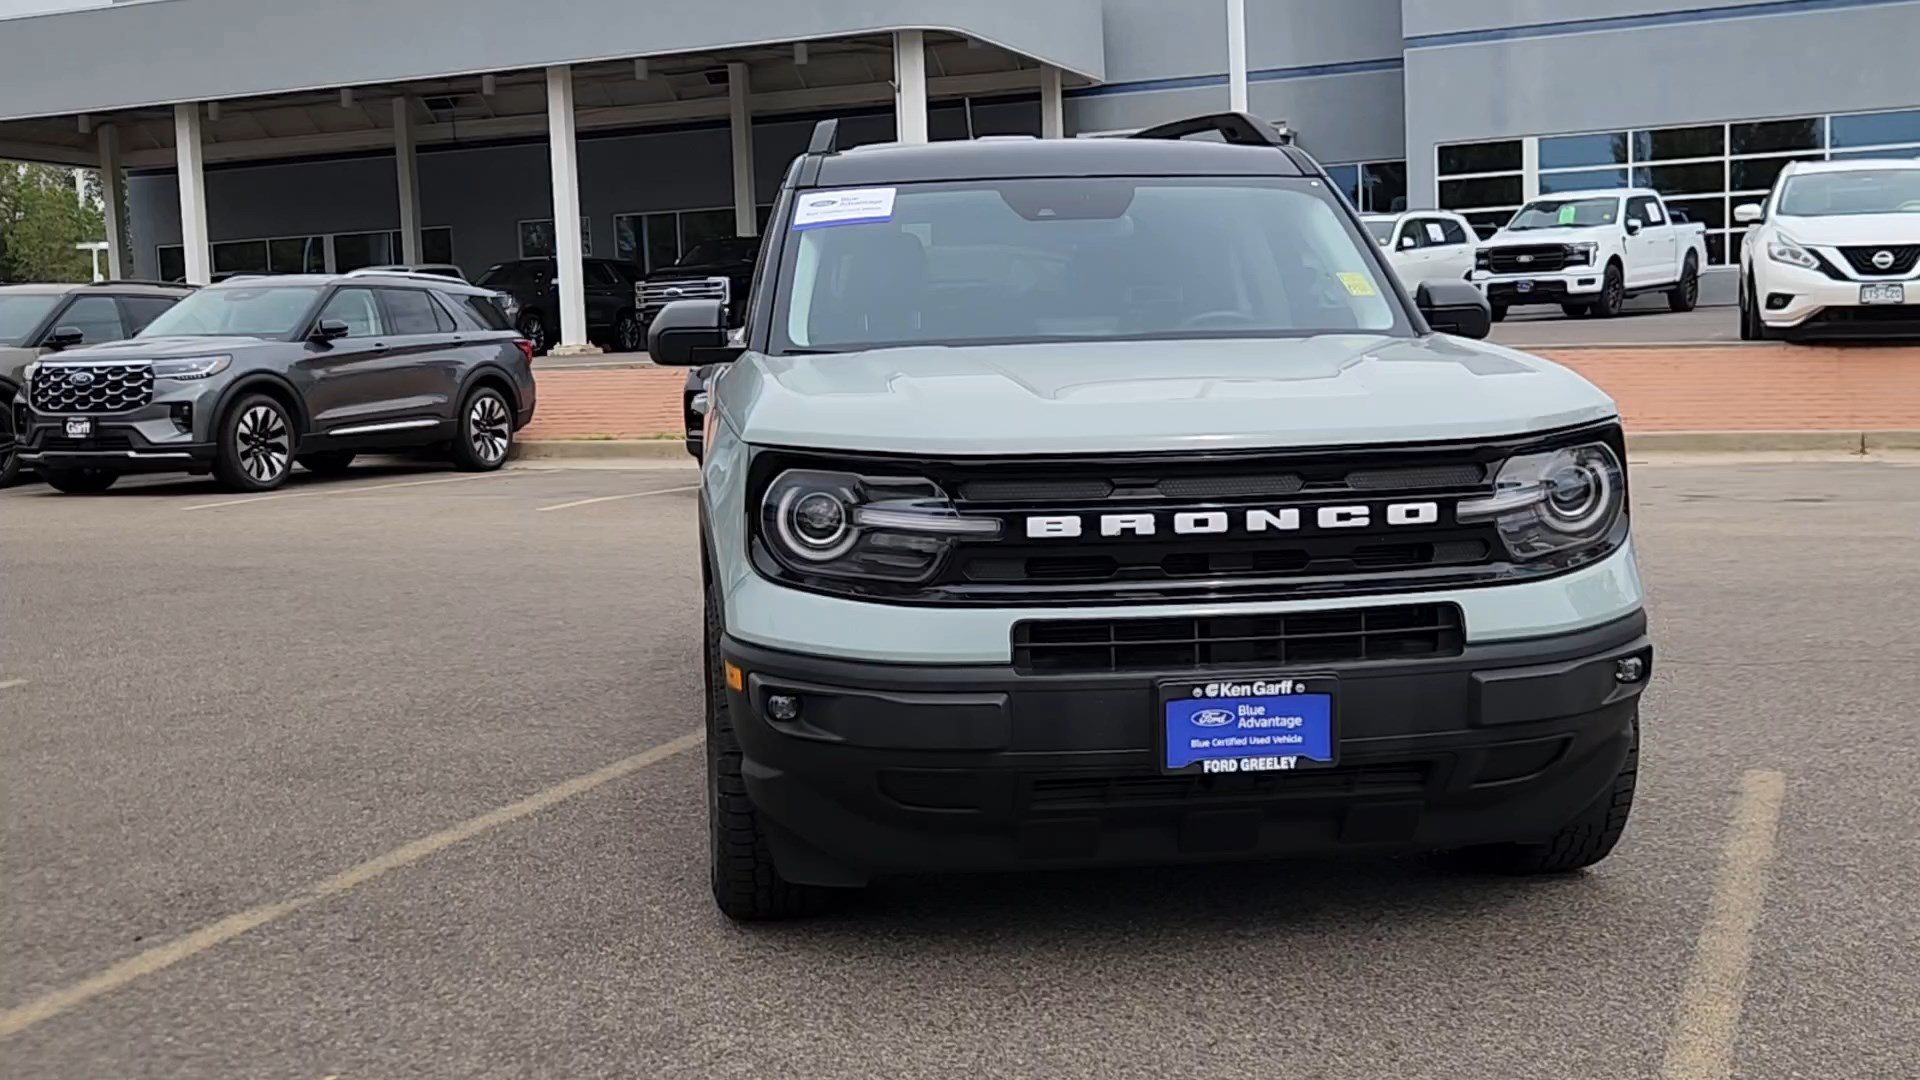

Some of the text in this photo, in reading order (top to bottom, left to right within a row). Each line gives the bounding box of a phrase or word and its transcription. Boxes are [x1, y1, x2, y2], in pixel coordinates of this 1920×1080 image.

[1026, 502, 1438, 537] BRONCO
[1220, 682, 1251, 697] Ken
[1253, 680, 1293, 696] Garff
[1238, 705, 1265, 716] Blue
[1199, 712, 1228, 725] Ford
[1238, 716, 1303, 729] Advantage
[1191, 734, 1302, 749] Blue Certified Used Vehicle
[1203, 756, 1297, 774] FORD GREELEY
